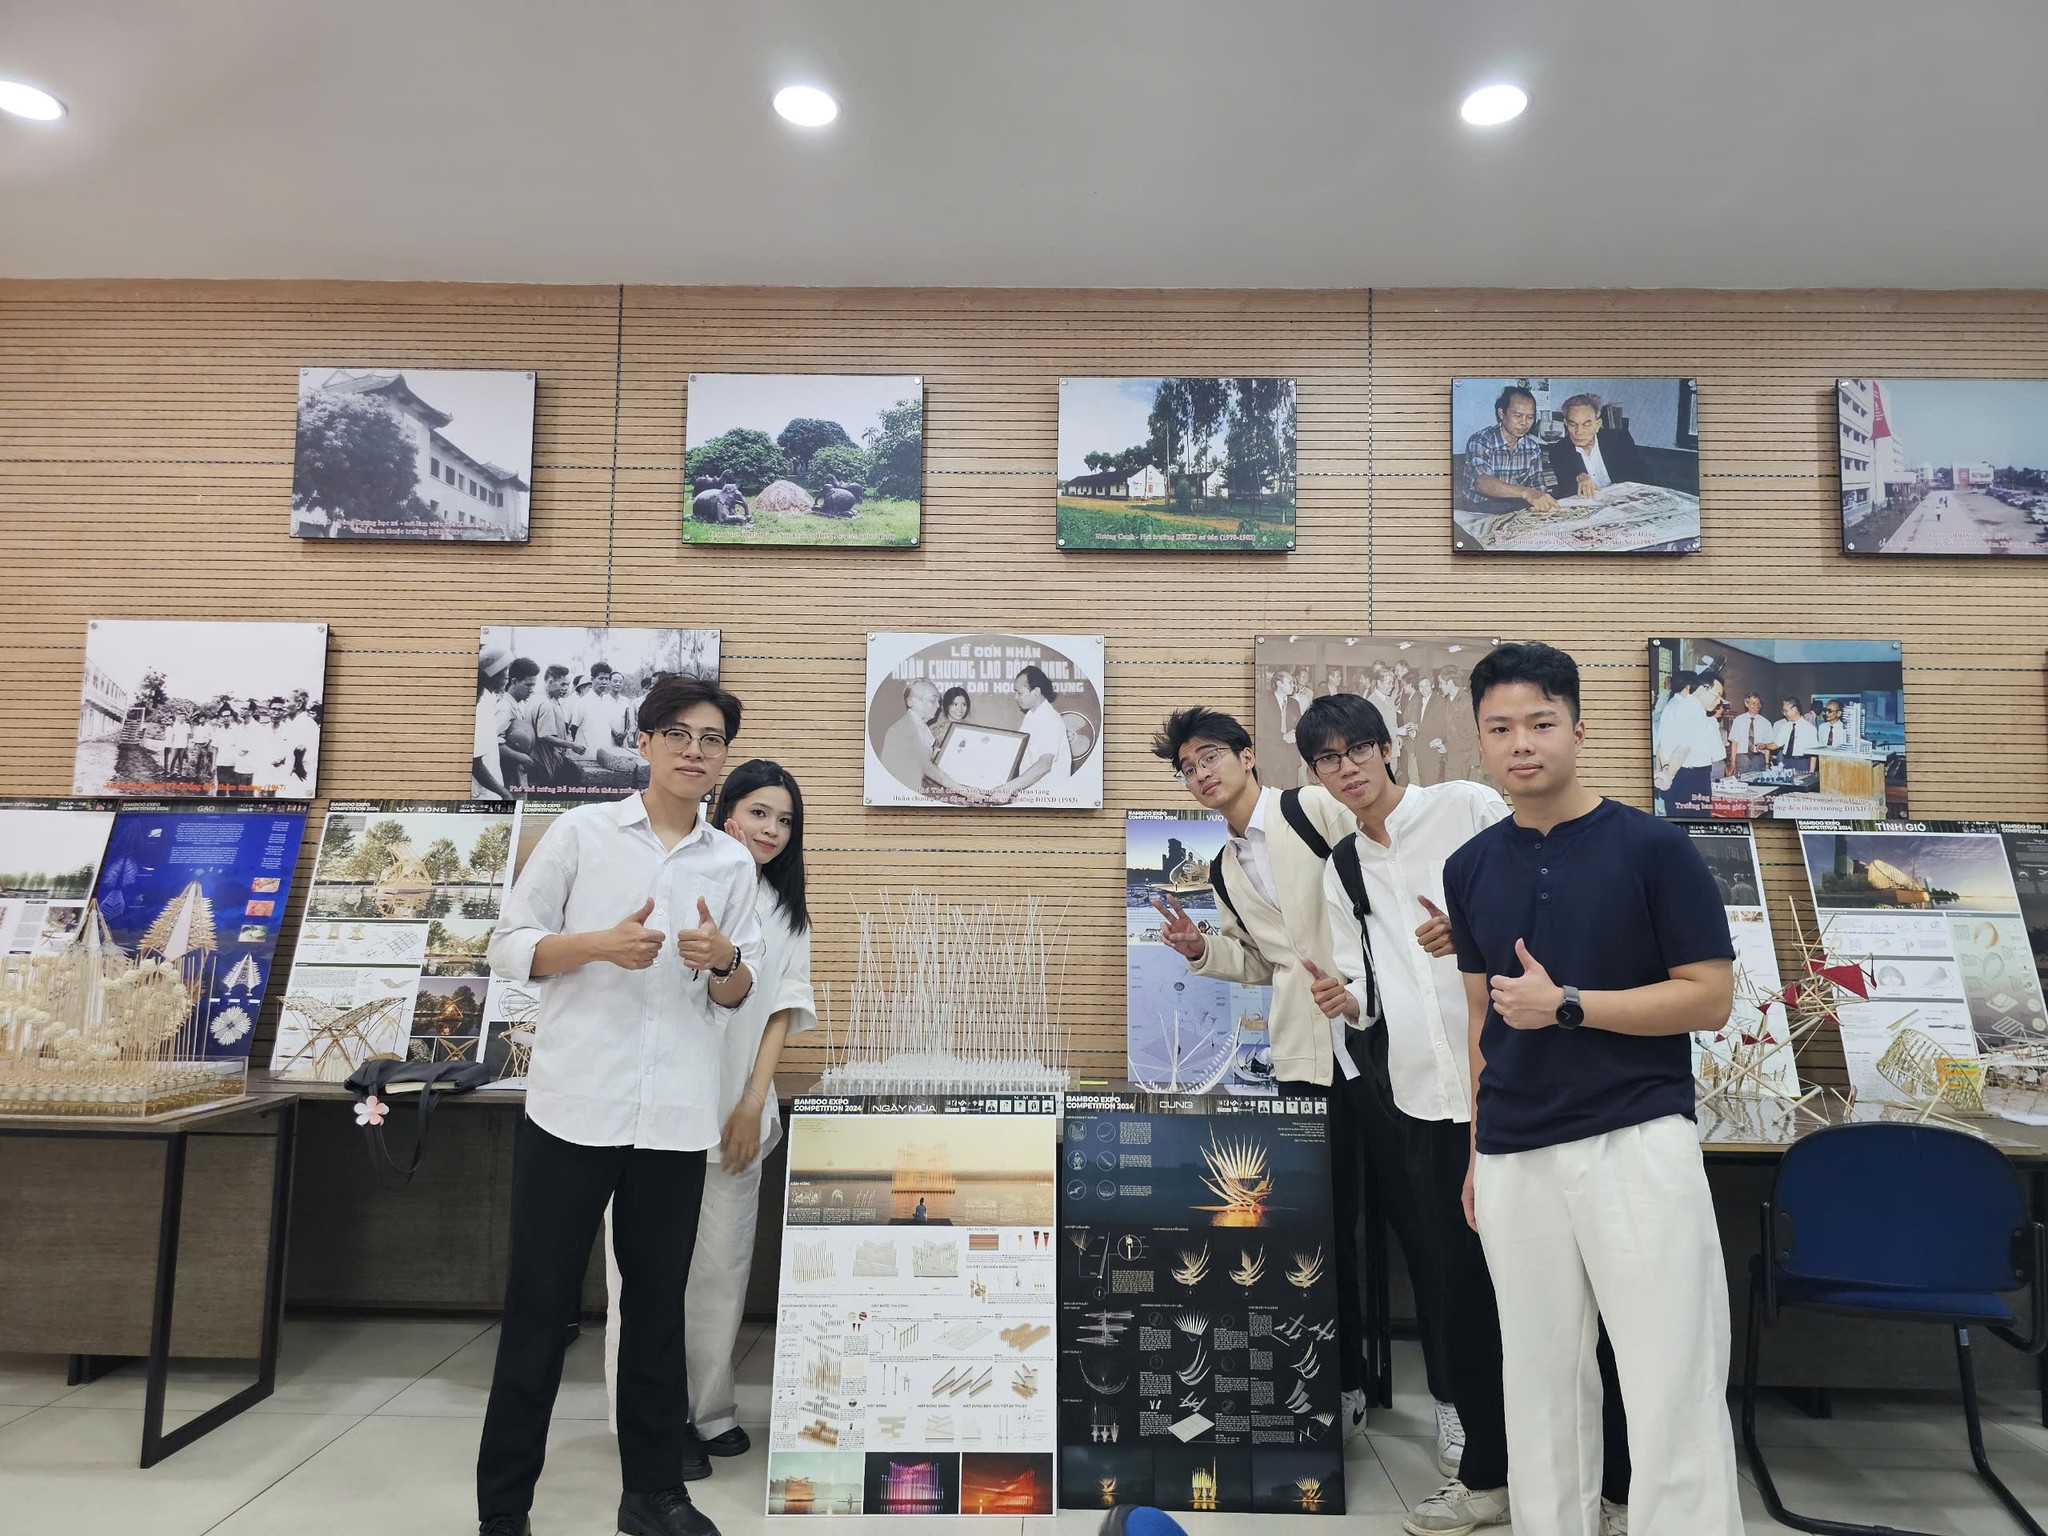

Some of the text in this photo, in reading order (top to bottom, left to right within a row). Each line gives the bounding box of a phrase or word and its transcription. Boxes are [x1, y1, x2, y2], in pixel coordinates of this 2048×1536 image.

[951, 643, 970, 658] LỄ
[980, 660, 1001, 680] LAO
[1875, 821, 1926, 832] TÌNH GIÓ
[872, 1102, 907, 1112] NGÀY
[908, 1102, 937, 1112] MÙA
[1066, 1102, 1135, 1110] COMPETITION 2024
[1159, 1100, 1194, 1109] CUNG
